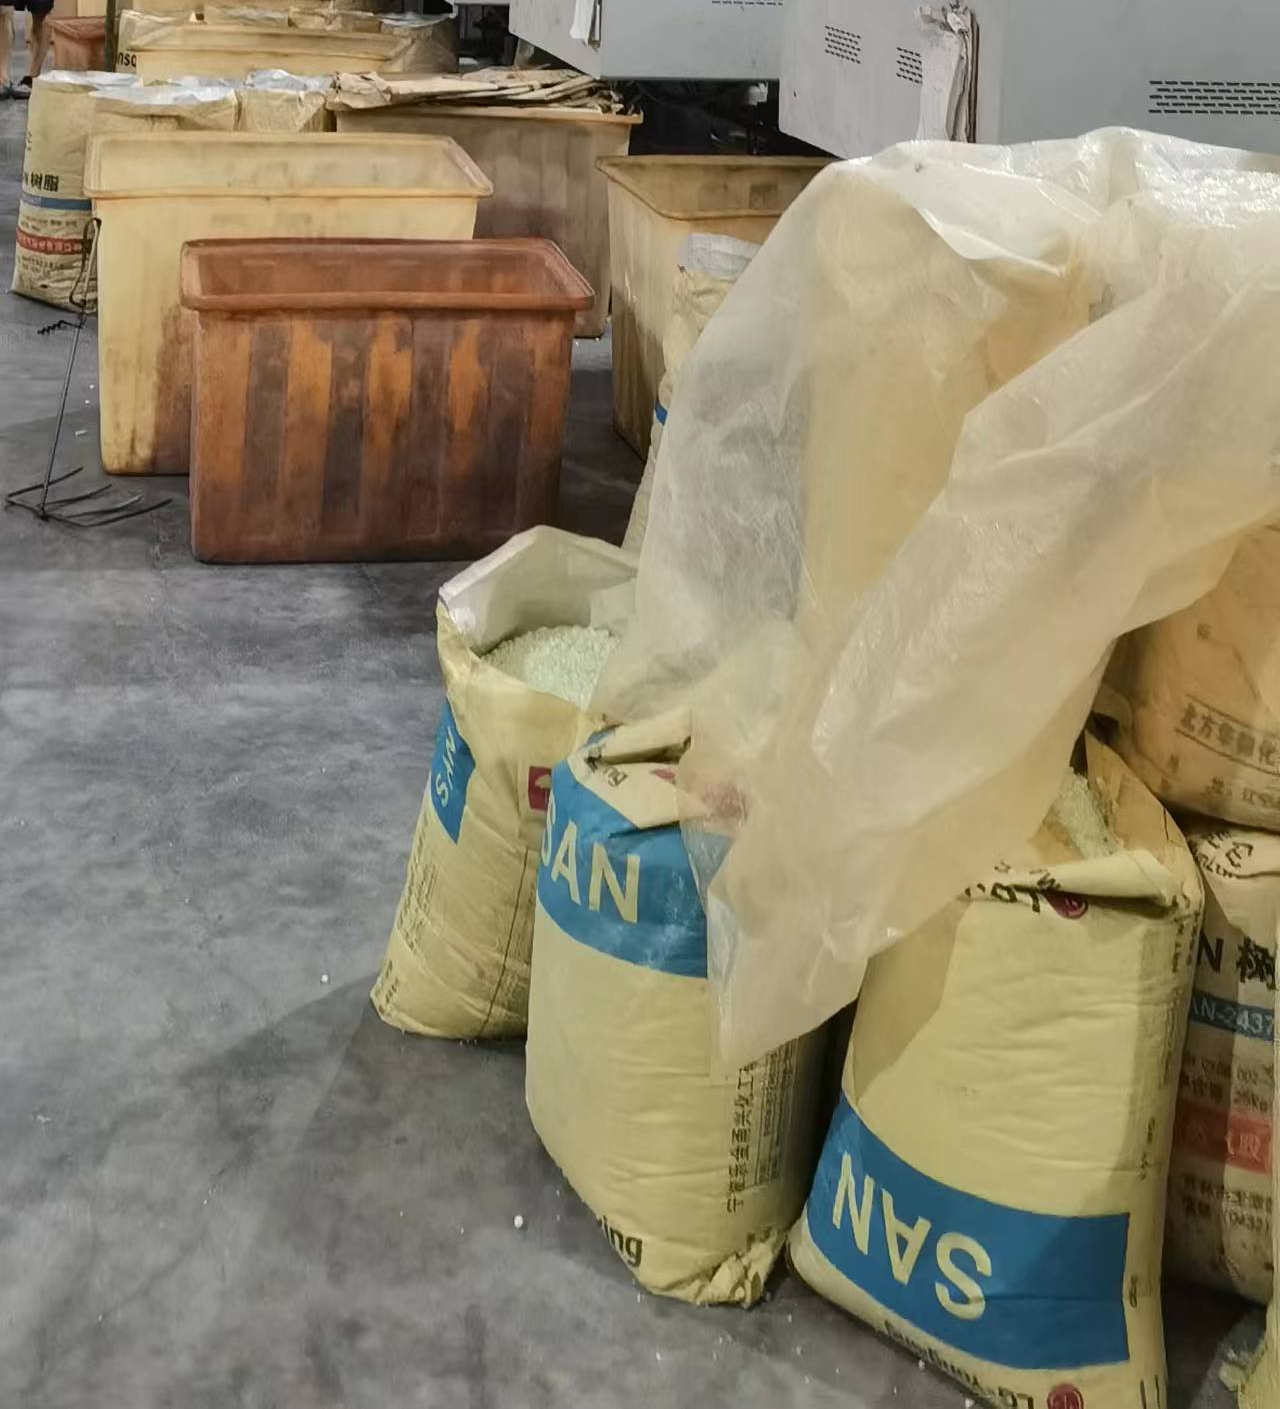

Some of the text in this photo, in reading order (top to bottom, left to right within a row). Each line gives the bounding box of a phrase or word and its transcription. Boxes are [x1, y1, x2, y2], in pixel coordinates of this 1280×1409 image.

[435, 725, 457, 808] SAN
[540, 789, 641, 925] SAN
[832, 1151, 993, 1321] SAN
